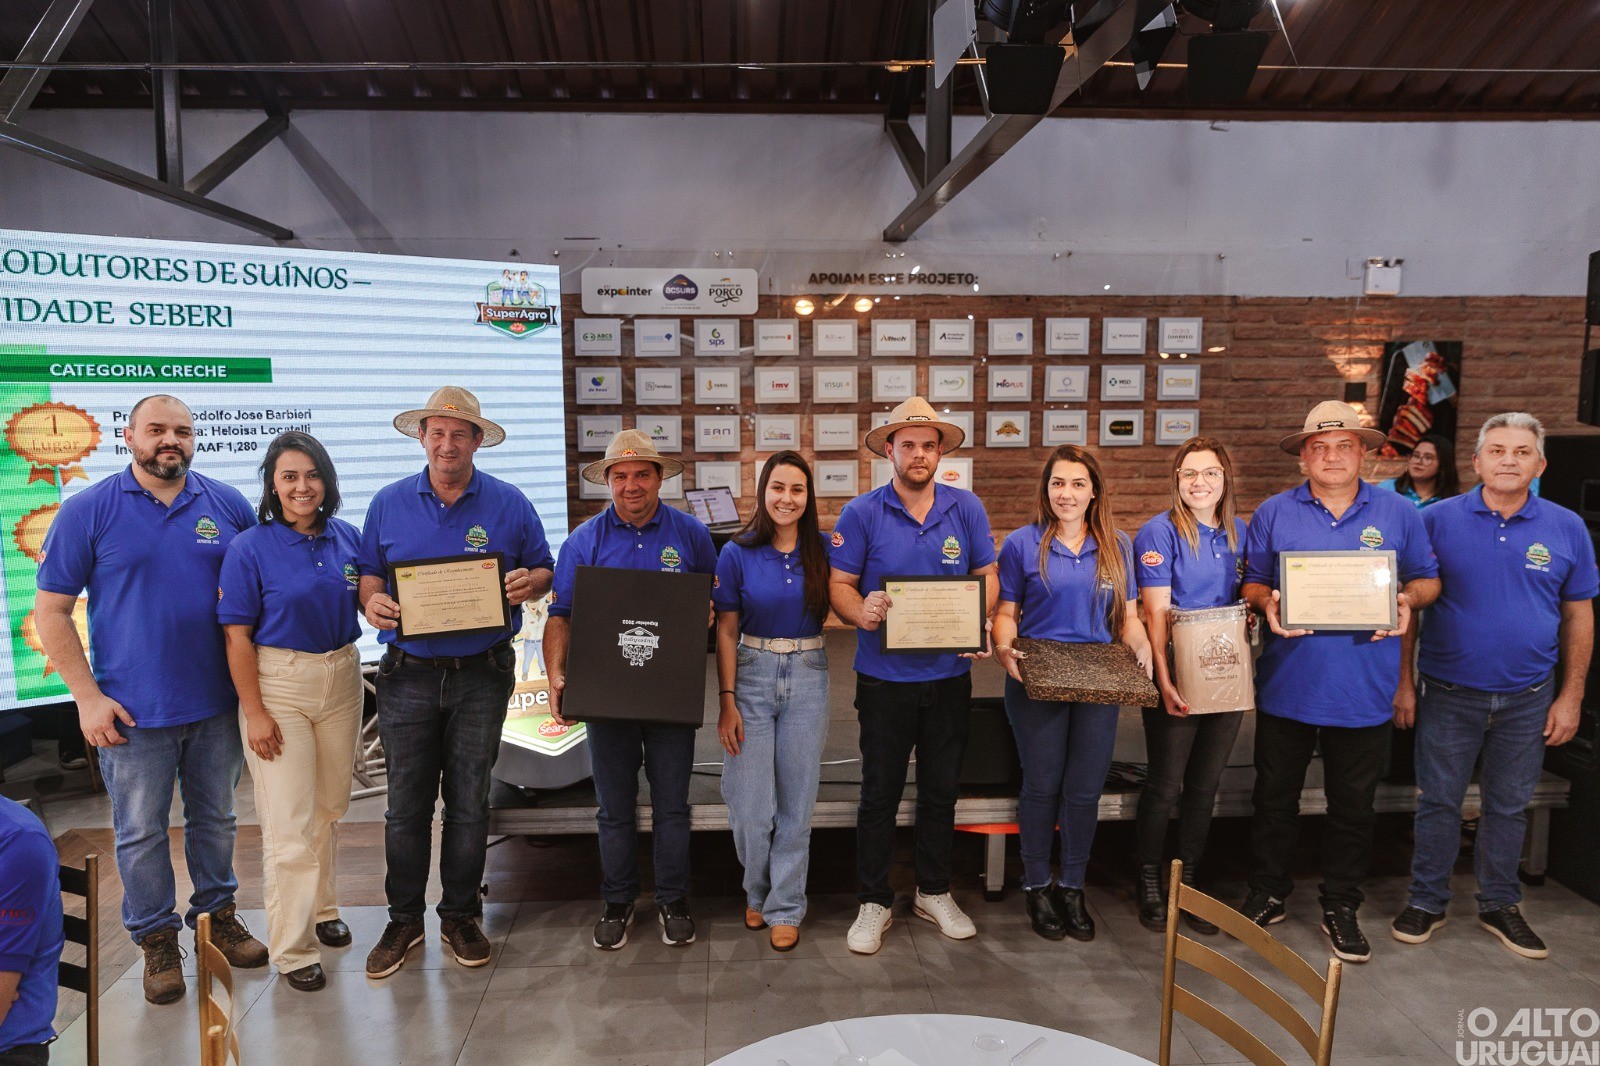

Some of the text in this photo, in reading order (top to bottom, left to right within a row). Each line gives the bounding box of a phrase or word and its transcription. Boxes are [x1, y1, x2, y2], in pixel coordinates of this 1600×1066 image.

[0, 249, 188, 282] ODUTORES
[193, 260, 237, 284] DE
[243, 261, 348, 289] SUÍNOS
[808, 272, 979, 285] APOIAM ESTE PROJETO:
[597, 286, 652, 298] expointer
[709, 288, 743, 297] PORCO
[129, 302, 232, 327] SEBERI
[486, 308, 548, 320] SuperAgro
[50, 363, 227, 378] CATEGORIA CRECHE
[771, 380, 789, 389] imv
[192, 409, 312, 421] odolfo Jose Barbieri
[212, 424, 257, 436] Heloisa
[194, 441, 258, 454] AAF 1,280
[508, 689, 550, 712] upe
[540, 724, 569, 735] Seara
